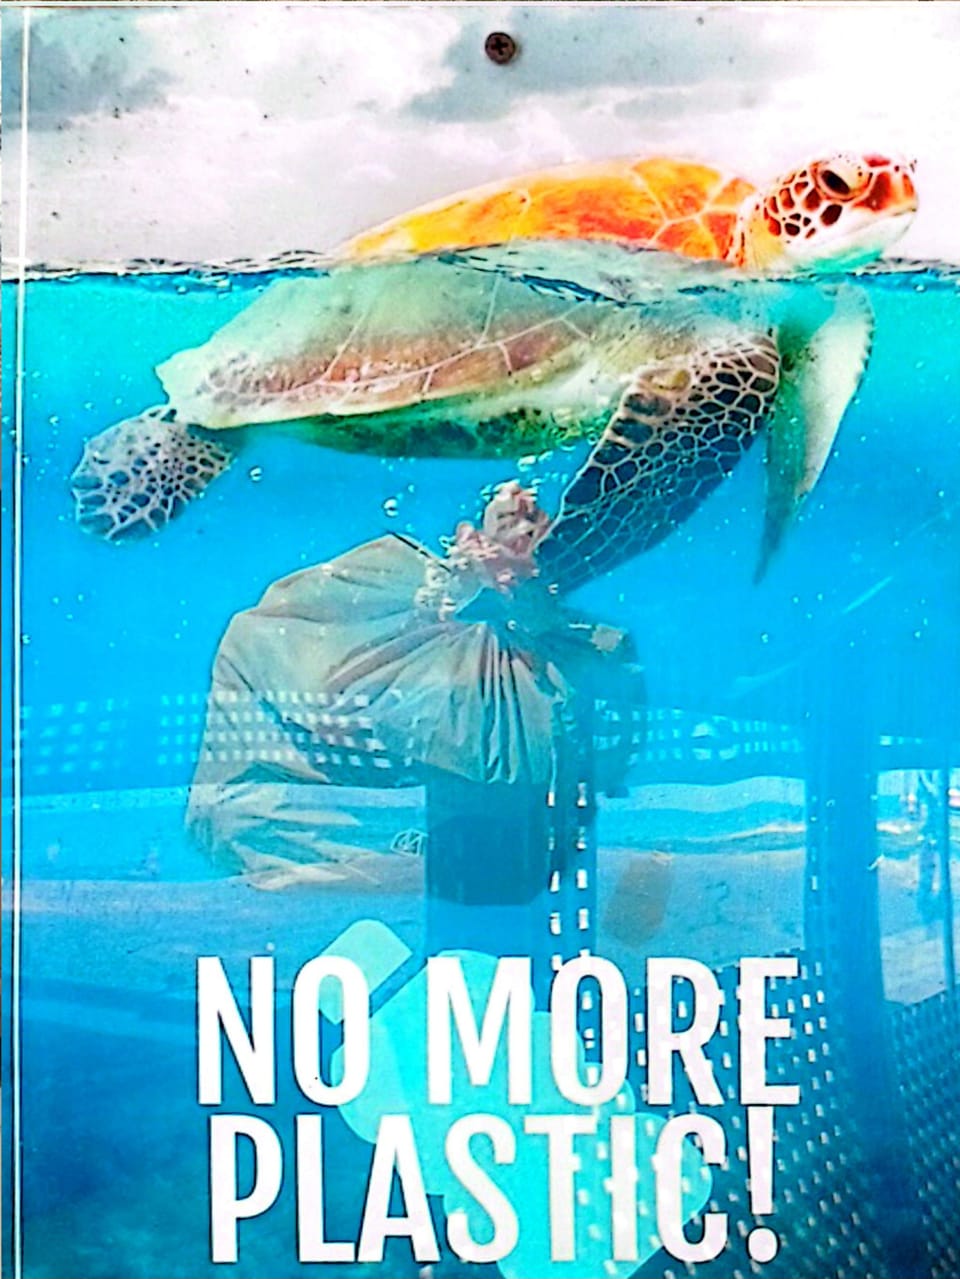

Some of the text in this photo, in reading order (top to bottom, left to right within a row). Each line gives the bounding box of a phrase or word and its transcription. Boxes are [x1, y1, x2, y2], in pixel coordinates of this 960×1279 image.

[197, 954, 800, 1107] NO MORE
[208, 1106, 781, 1264] PLASTIC!
